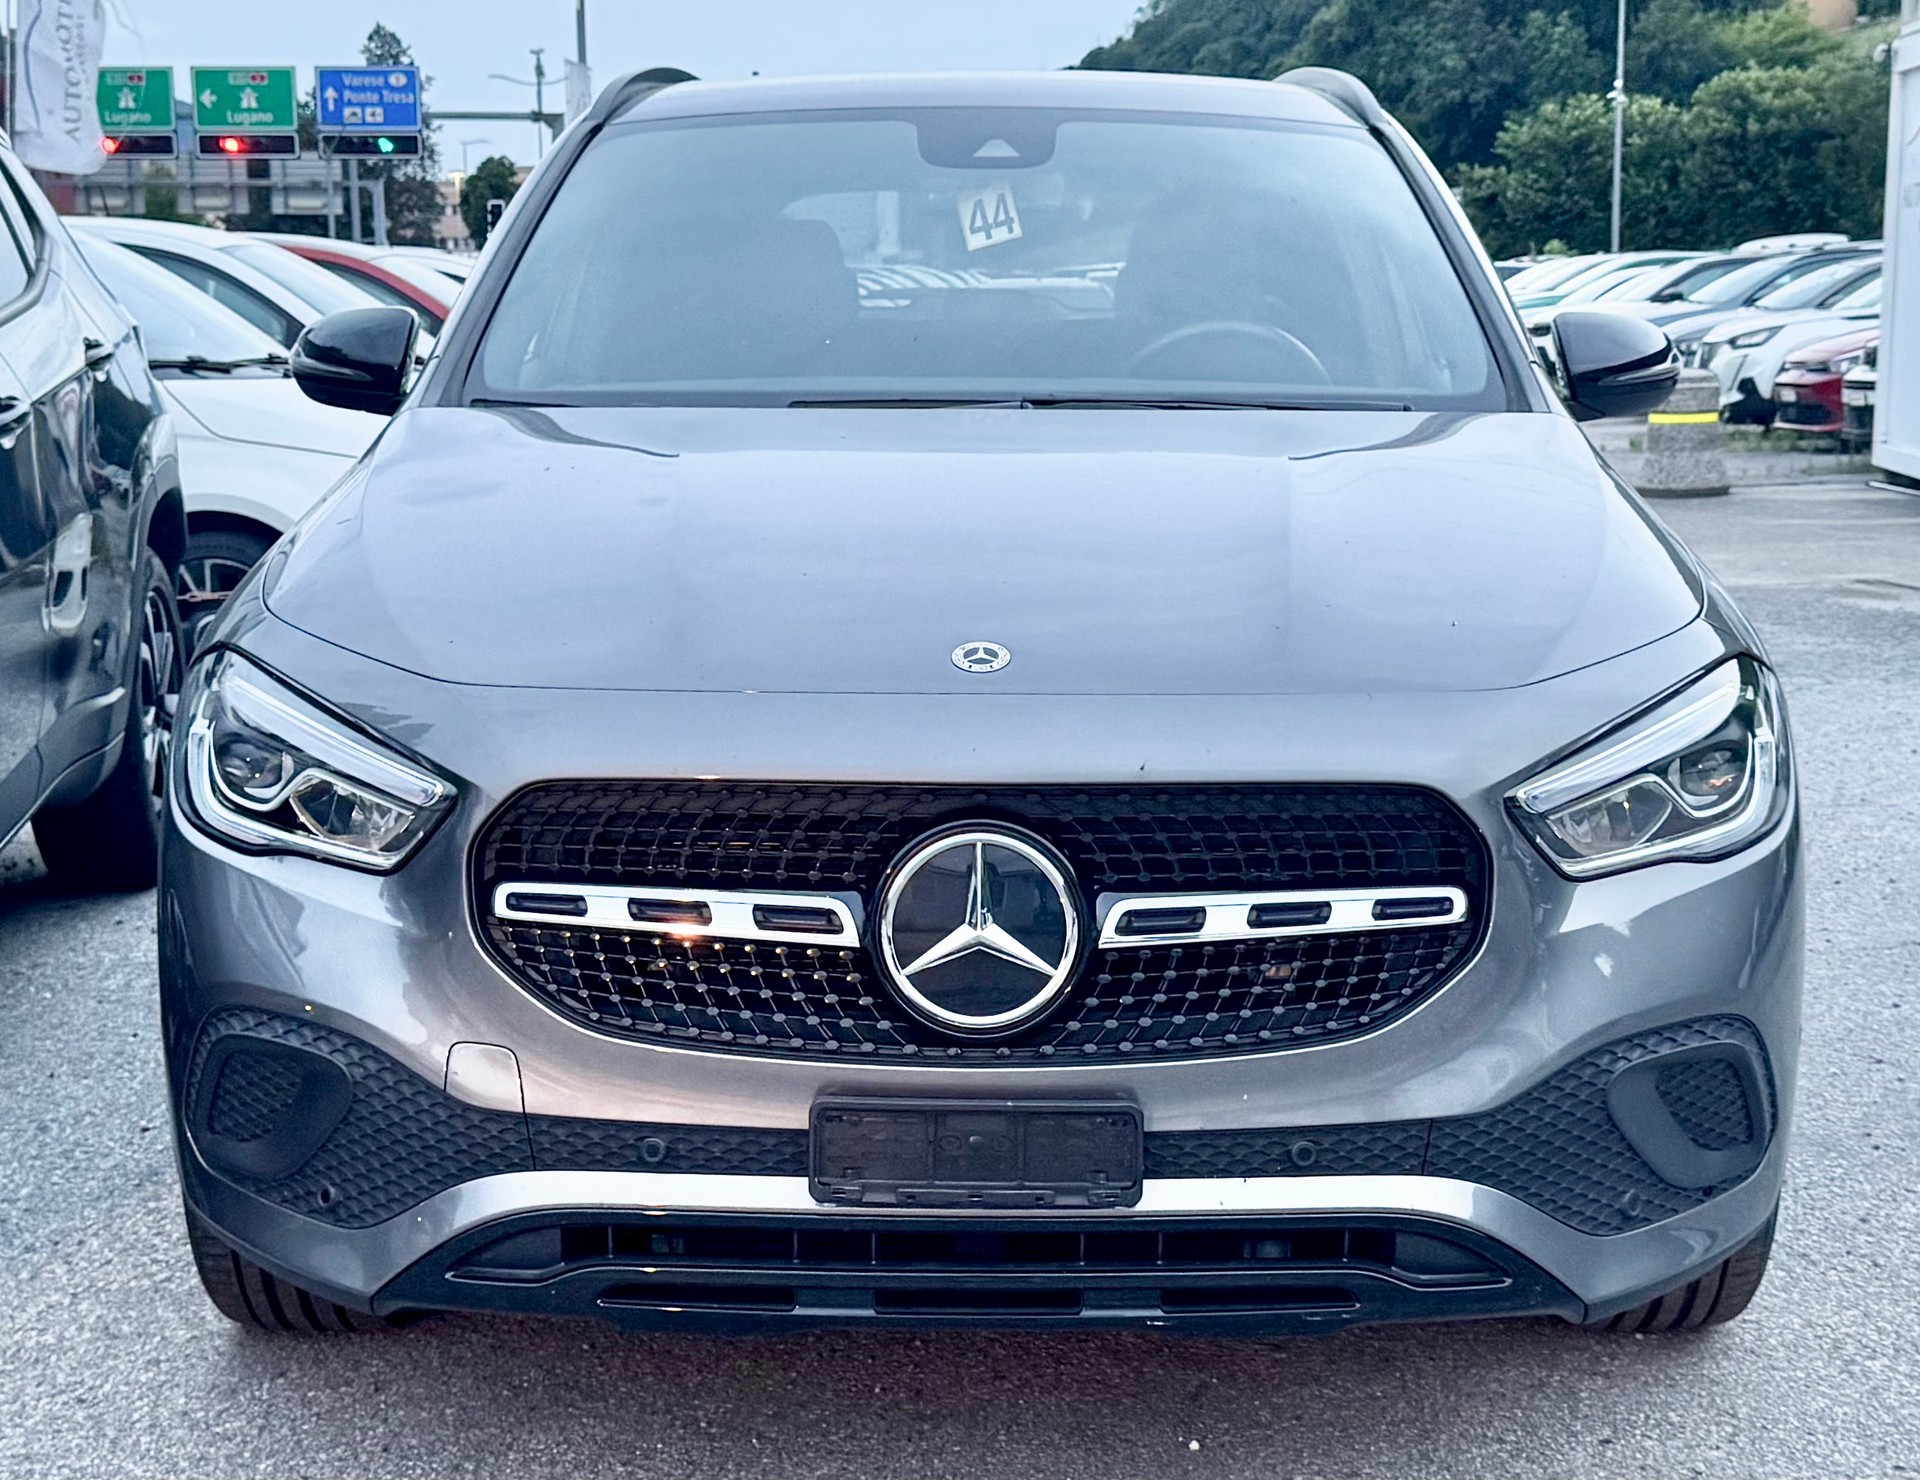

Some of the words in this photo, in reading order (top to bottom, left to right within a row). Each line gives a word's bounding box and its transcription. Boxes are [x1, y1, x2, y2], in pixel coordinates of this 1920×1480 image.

[342, 72, 385, 87] Varese
[343, 90, 380, 104] Ponte
[382, 90, 415, 105] Tresa
[104, 111, 152, 126] Lugano
[226, 109, 274, 126] Lugano
[969, 193, 1015, 240] 44
